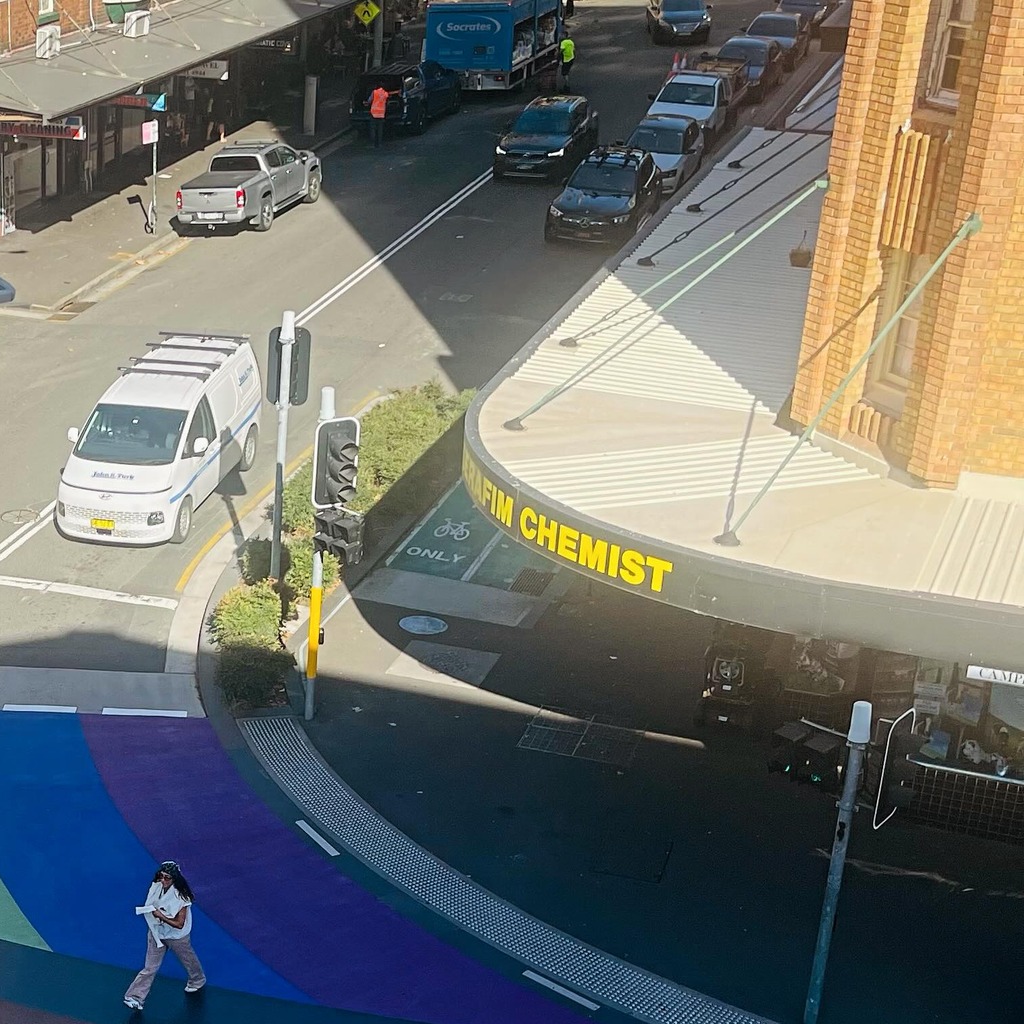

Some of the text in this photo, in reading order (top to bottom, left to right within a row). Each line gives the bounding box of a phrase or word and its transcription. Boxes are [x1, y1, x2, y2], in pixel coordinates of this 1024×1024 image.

[446, 22, 492, 32] Socrates
[20, 123, 72, 137] CLEANING
[406, 546, 466, 563] ONLY
[519, 506, 673, 593] CHEMIST
[979, 668, 1024, 685] CAMP
